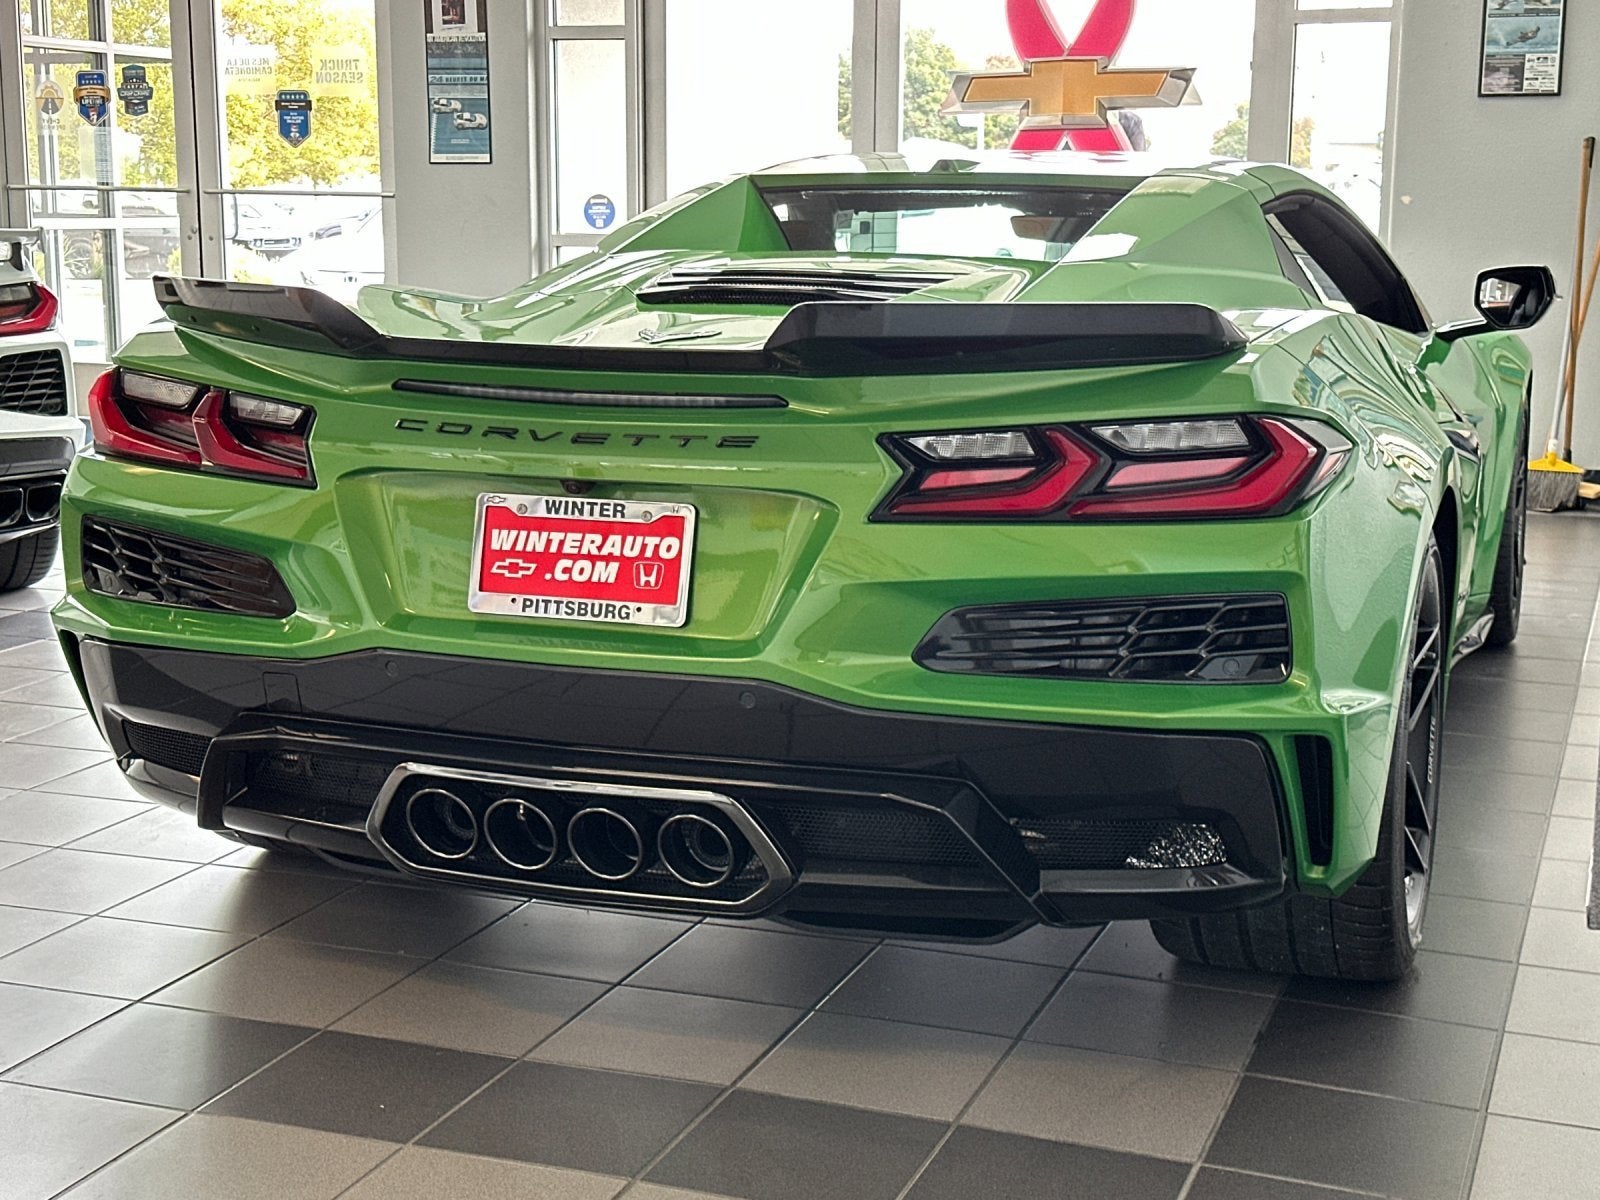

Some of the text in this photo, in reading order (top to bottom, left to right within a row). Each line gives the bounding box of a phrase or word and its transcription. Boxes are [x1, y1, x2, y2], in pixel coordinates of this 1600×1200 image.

[394, 417, 761, 449] CORVETTE
[544, 499, 627, 519] WINTER
[490, 528, 680, 560] WINTERAUTO
[544, 559, 620, 584] .COM
[521, 598, 632, 621] PITTSBURG
[1427, 715, 1436, 784] CORVETTE
